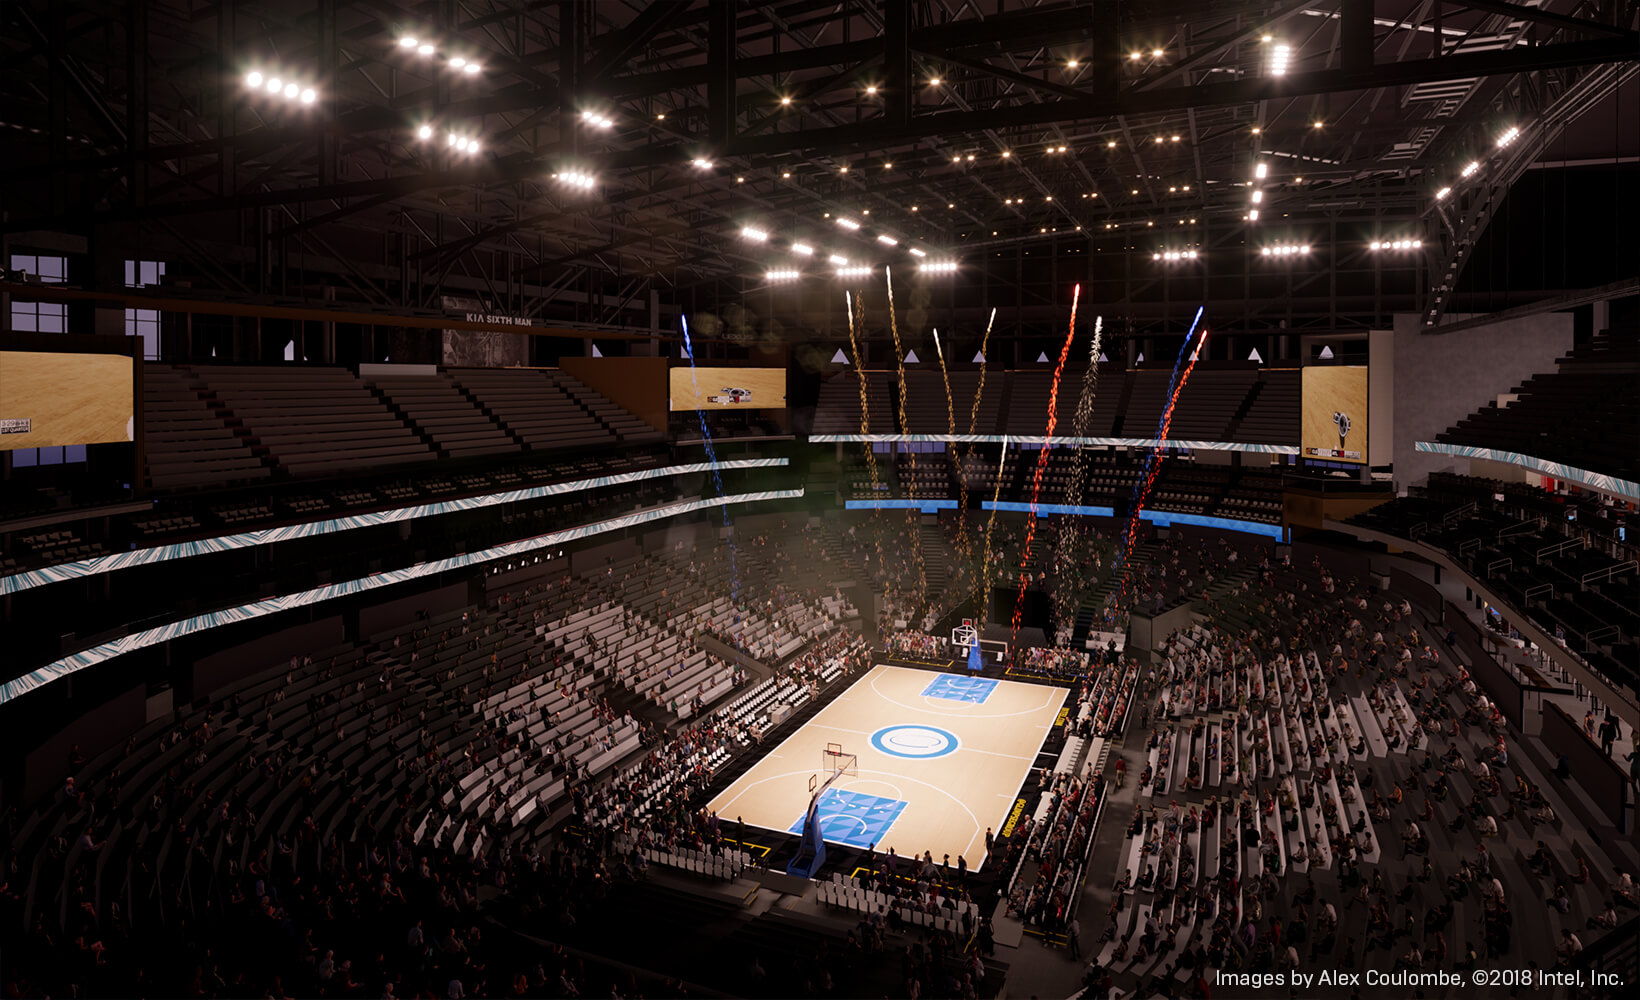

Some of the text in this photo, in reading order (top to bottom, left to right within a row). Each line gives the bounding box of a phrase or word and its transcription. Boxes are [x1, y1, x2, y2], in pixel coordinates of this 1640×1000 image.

[466, 313, 532, 327] KIA SIXTH MAN
